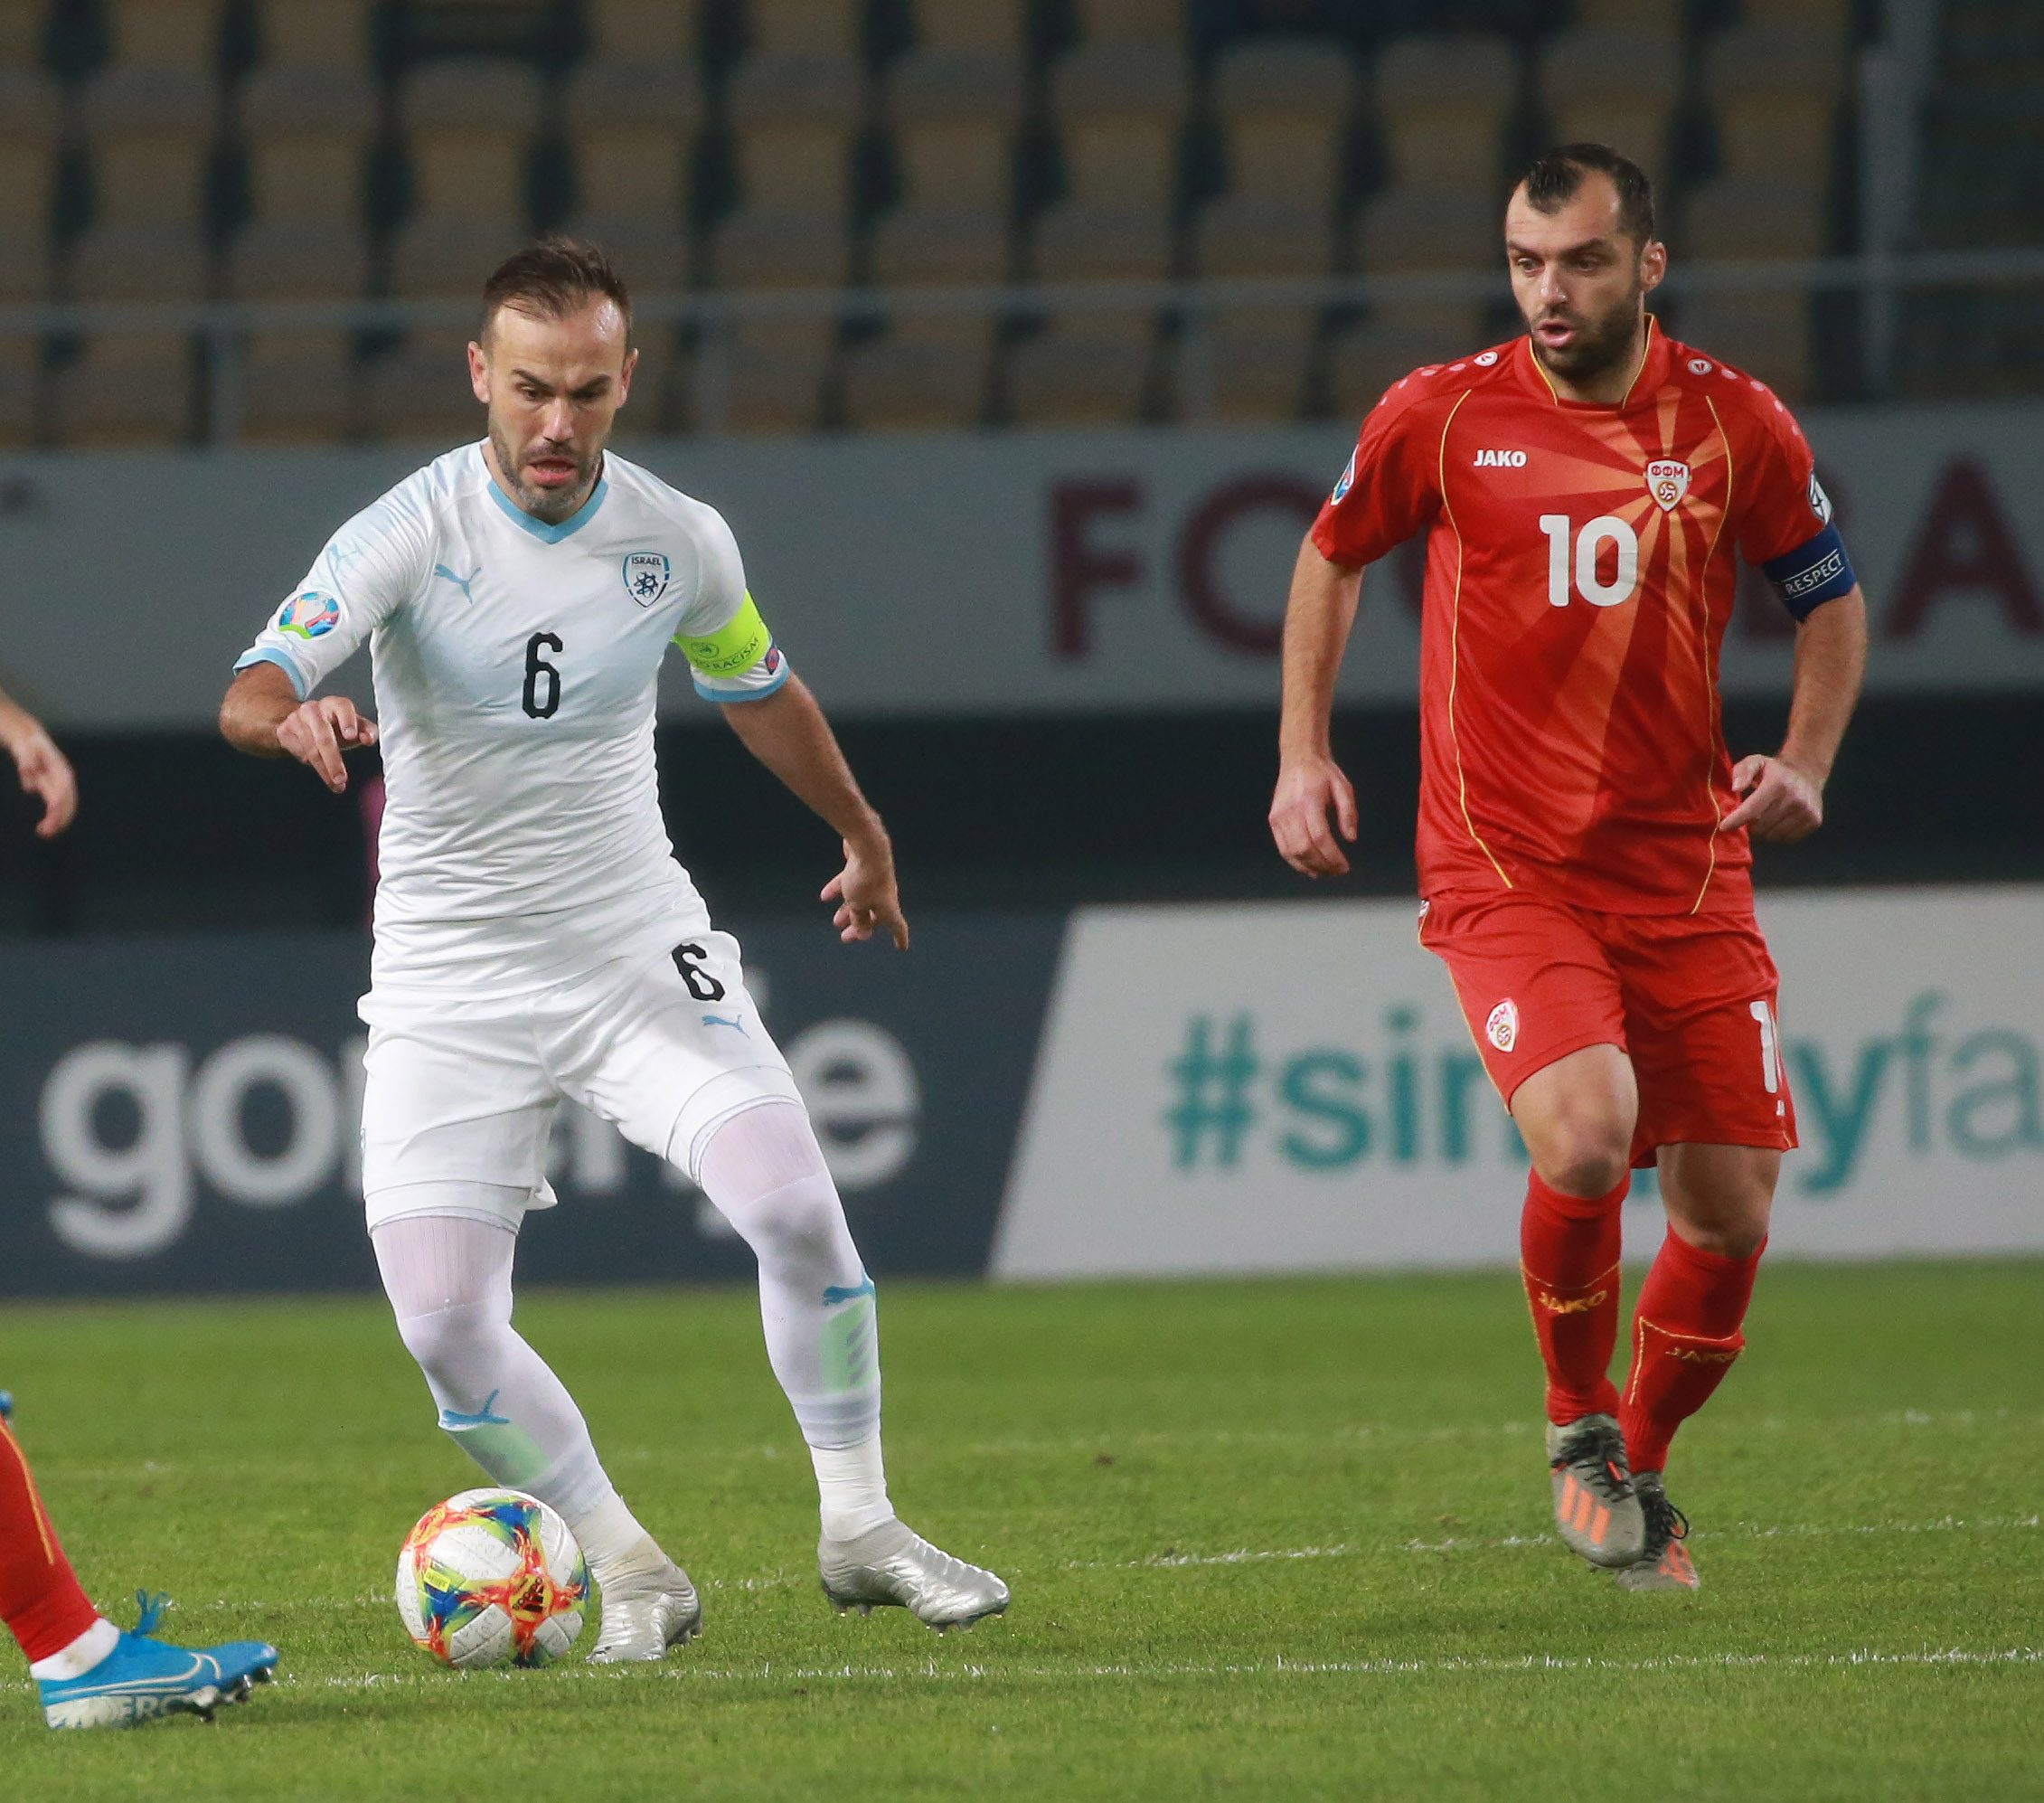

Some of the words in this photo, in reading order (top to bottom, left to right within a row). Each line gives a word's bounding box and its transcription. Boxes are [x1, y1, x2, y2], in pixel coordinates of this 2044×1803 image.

[1473, 449, 1528, 467] JAKO
[631, 556, 662, 566] ISRAEL
[1539, 514, 1639, 607] 10
[1785, 552, 1842, 595] RESPECT
[712, 636, 759, 668] RACISM
[521, 632, 563, 719] 6
[671, 943, 725, 1001] 6
